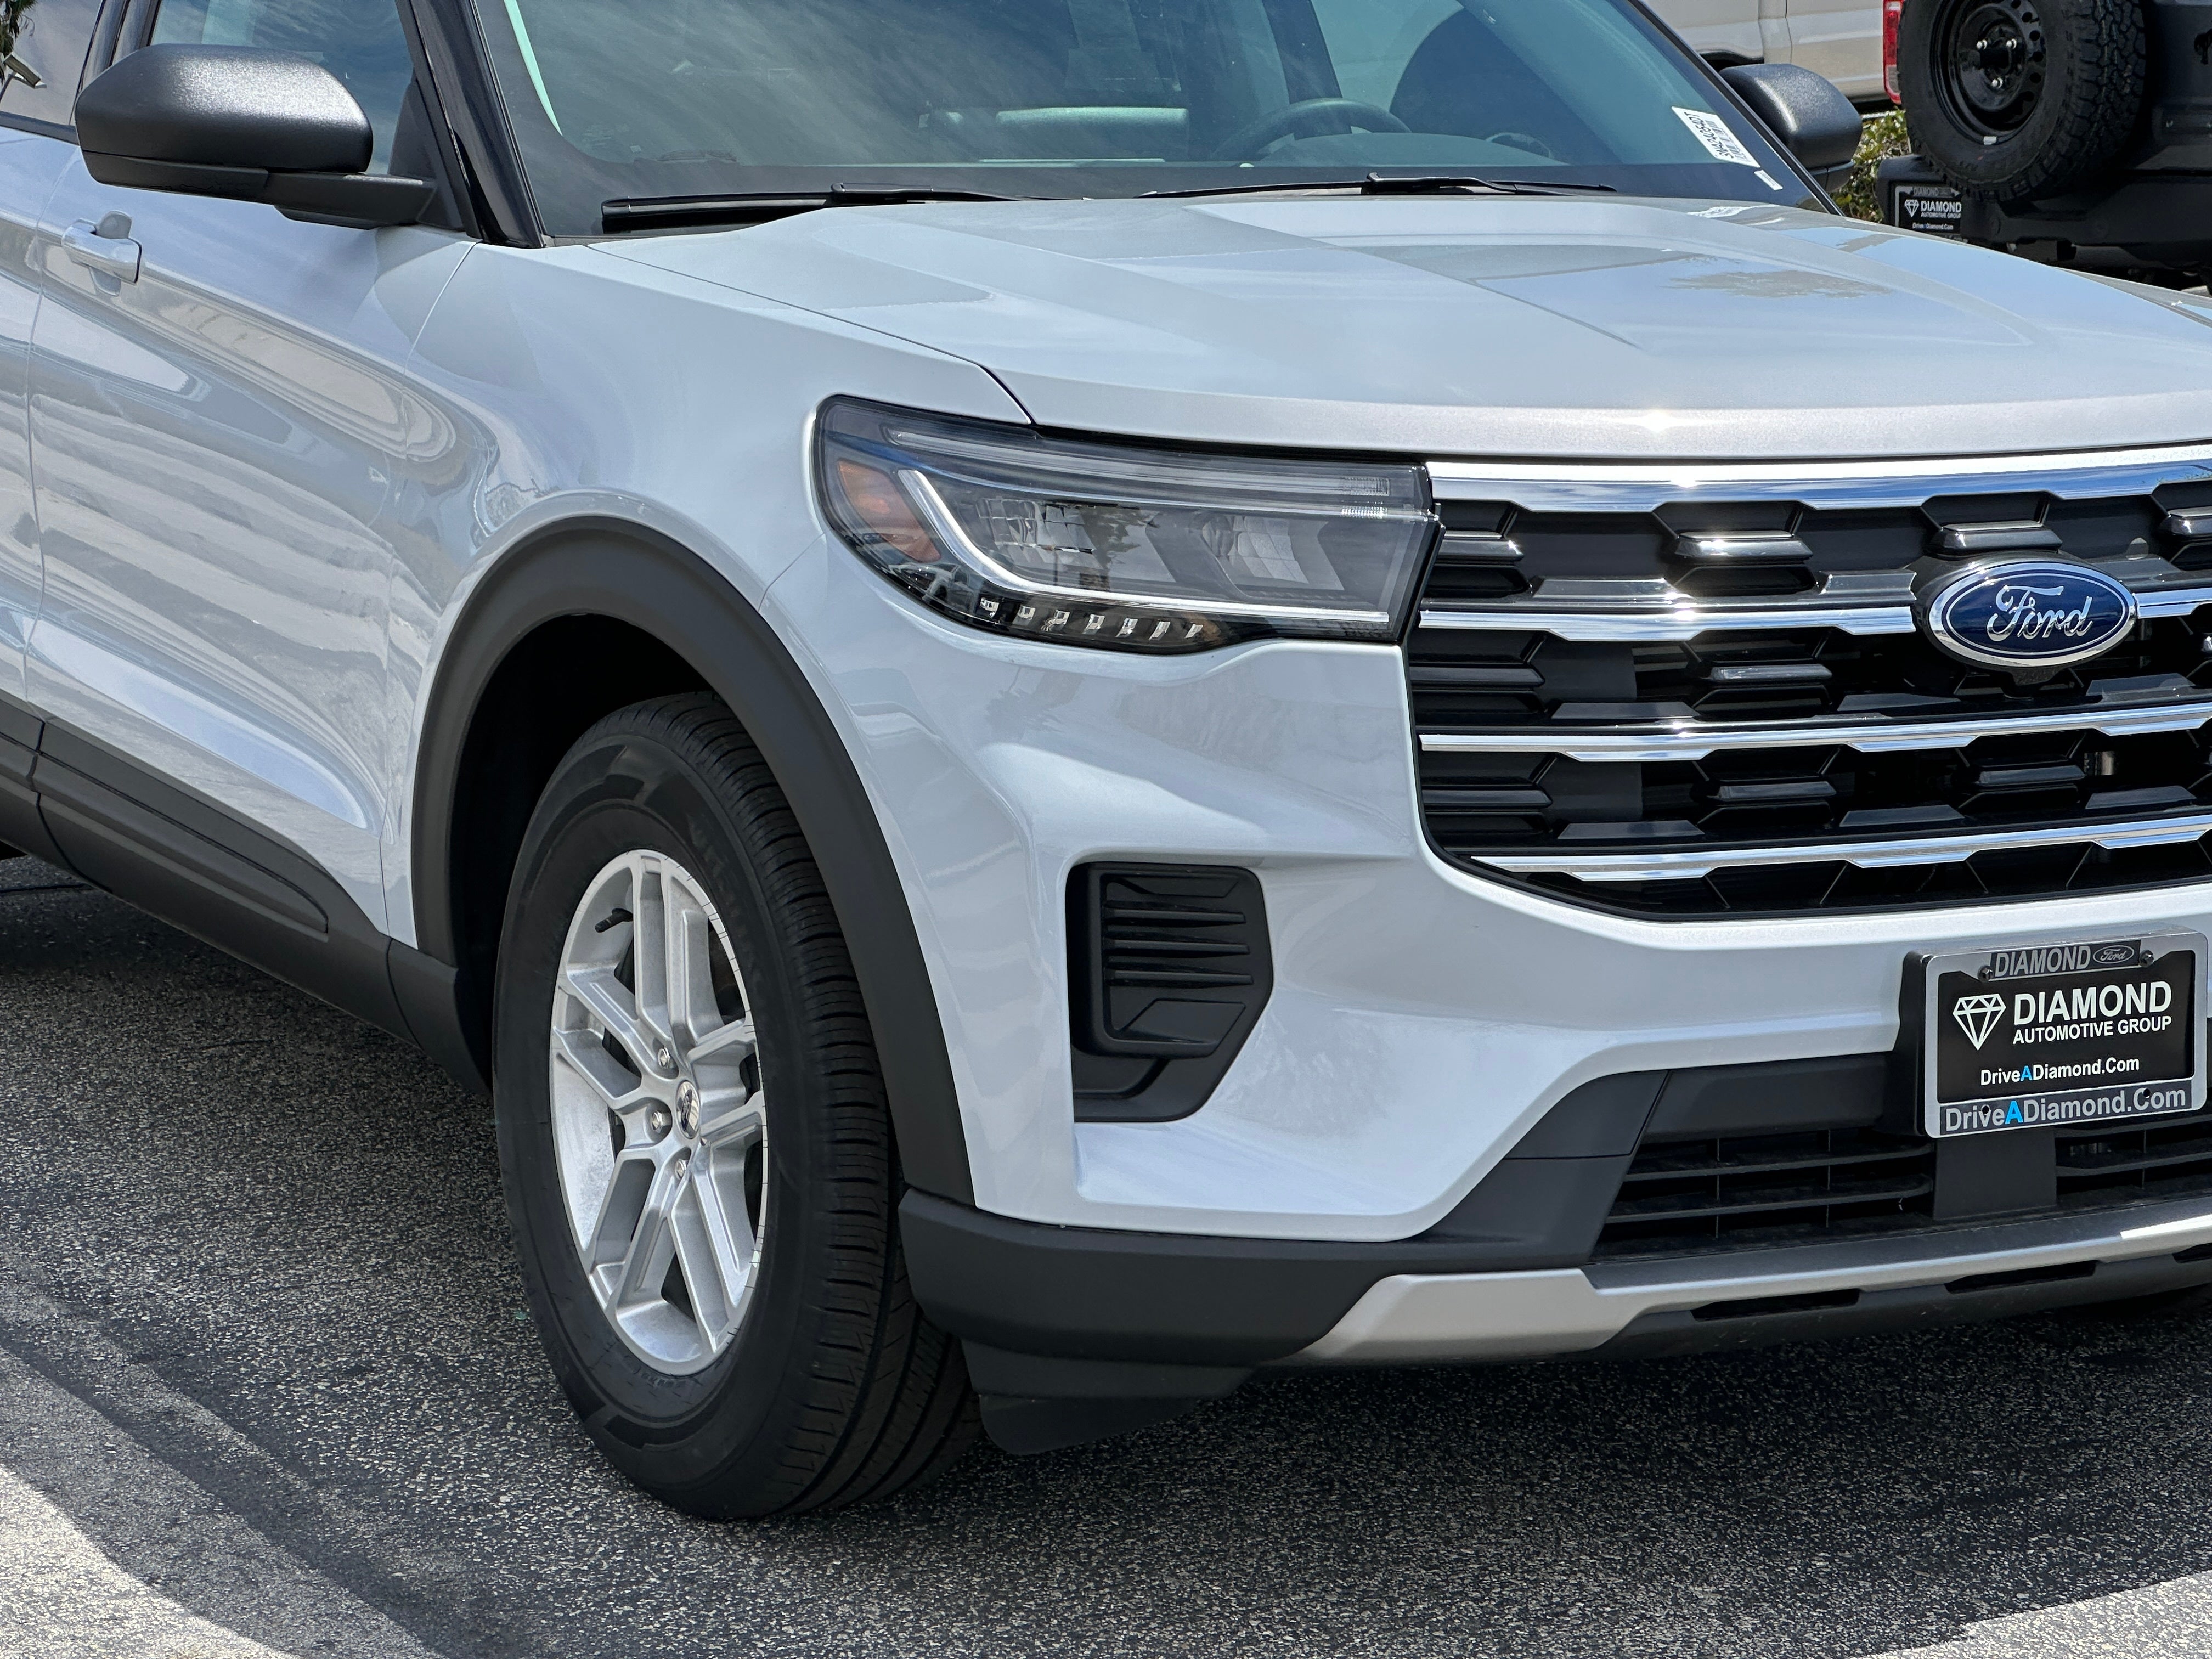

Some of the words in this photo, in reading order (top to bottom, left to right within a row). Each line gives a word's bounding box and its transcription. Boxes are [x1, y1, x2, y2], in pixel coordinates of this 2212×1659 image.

[1921, 201, 1962, 213] DIAMOND
[1987, 585, 2093, 642] Ford
[1995, 945, 2091, 978] DIAMOND
[2100, 948, 2126, 961] Ford
[2014, 981, 2172, 1025] DIAMOND
[2013, 1020, 2114, 1045] AUTOMOTIVE
[2117, 1015, 2172, 1035] GROUP
[1980, 1057, 2140, 1086] DriveADiamond.Com
[1945, 1088, 2186, 1131] DriveADiamond.Com
